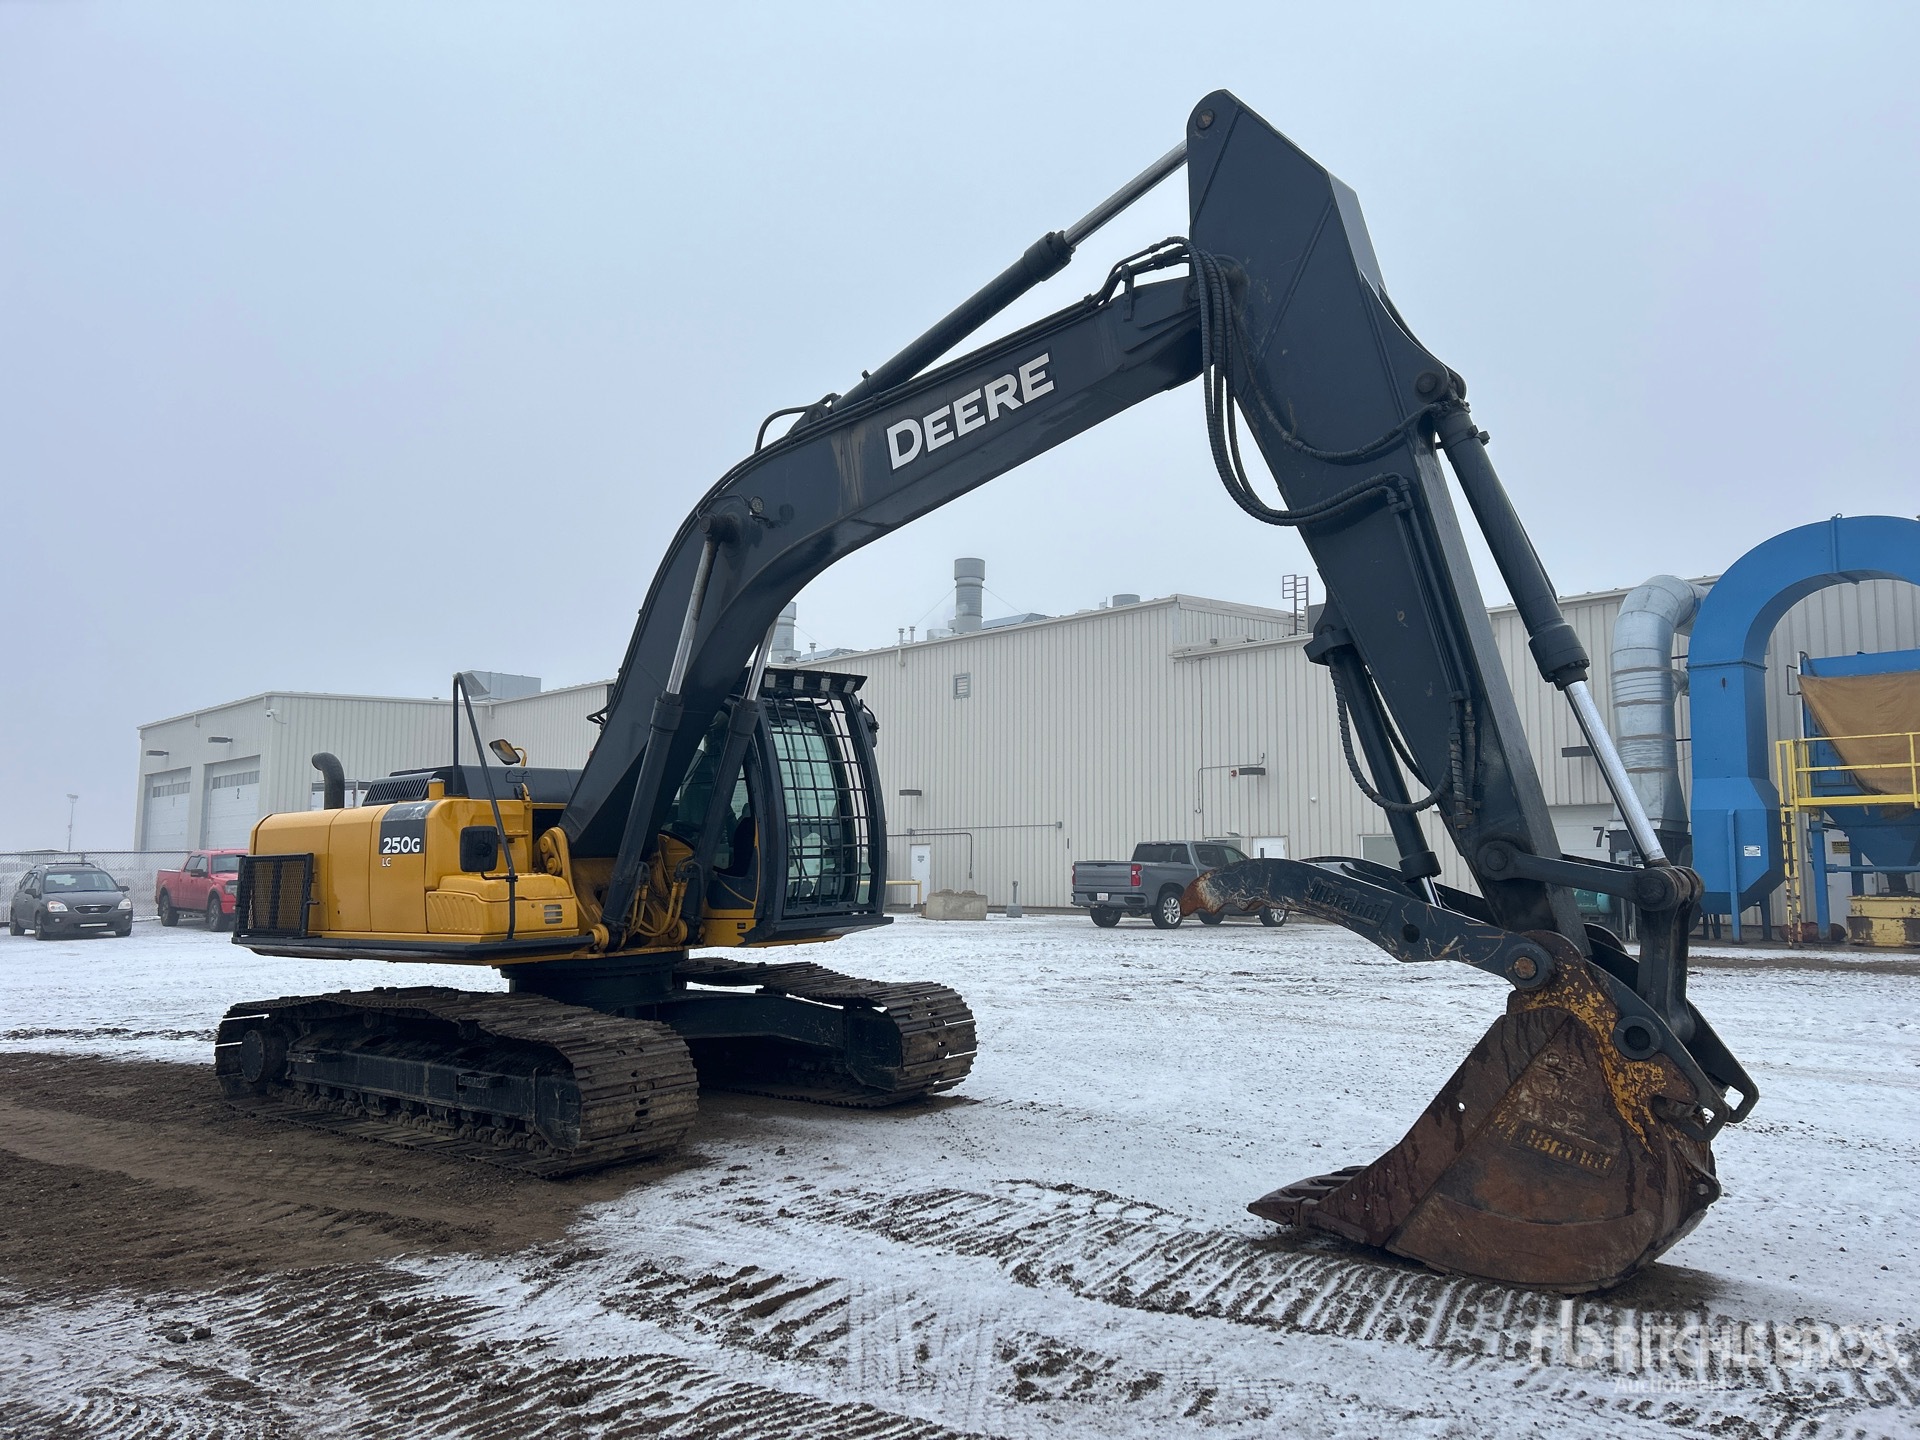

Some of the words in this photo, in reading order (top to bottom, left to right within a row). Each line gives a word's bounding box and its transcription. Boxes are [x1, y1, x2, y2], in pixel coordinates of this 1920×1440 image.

[887, 352, 1055, 470] DEERE
[382, 836, 421, 854] 250G
[1593, 827, 1605, 848] 7
[382, 857, 392, 868] LC
